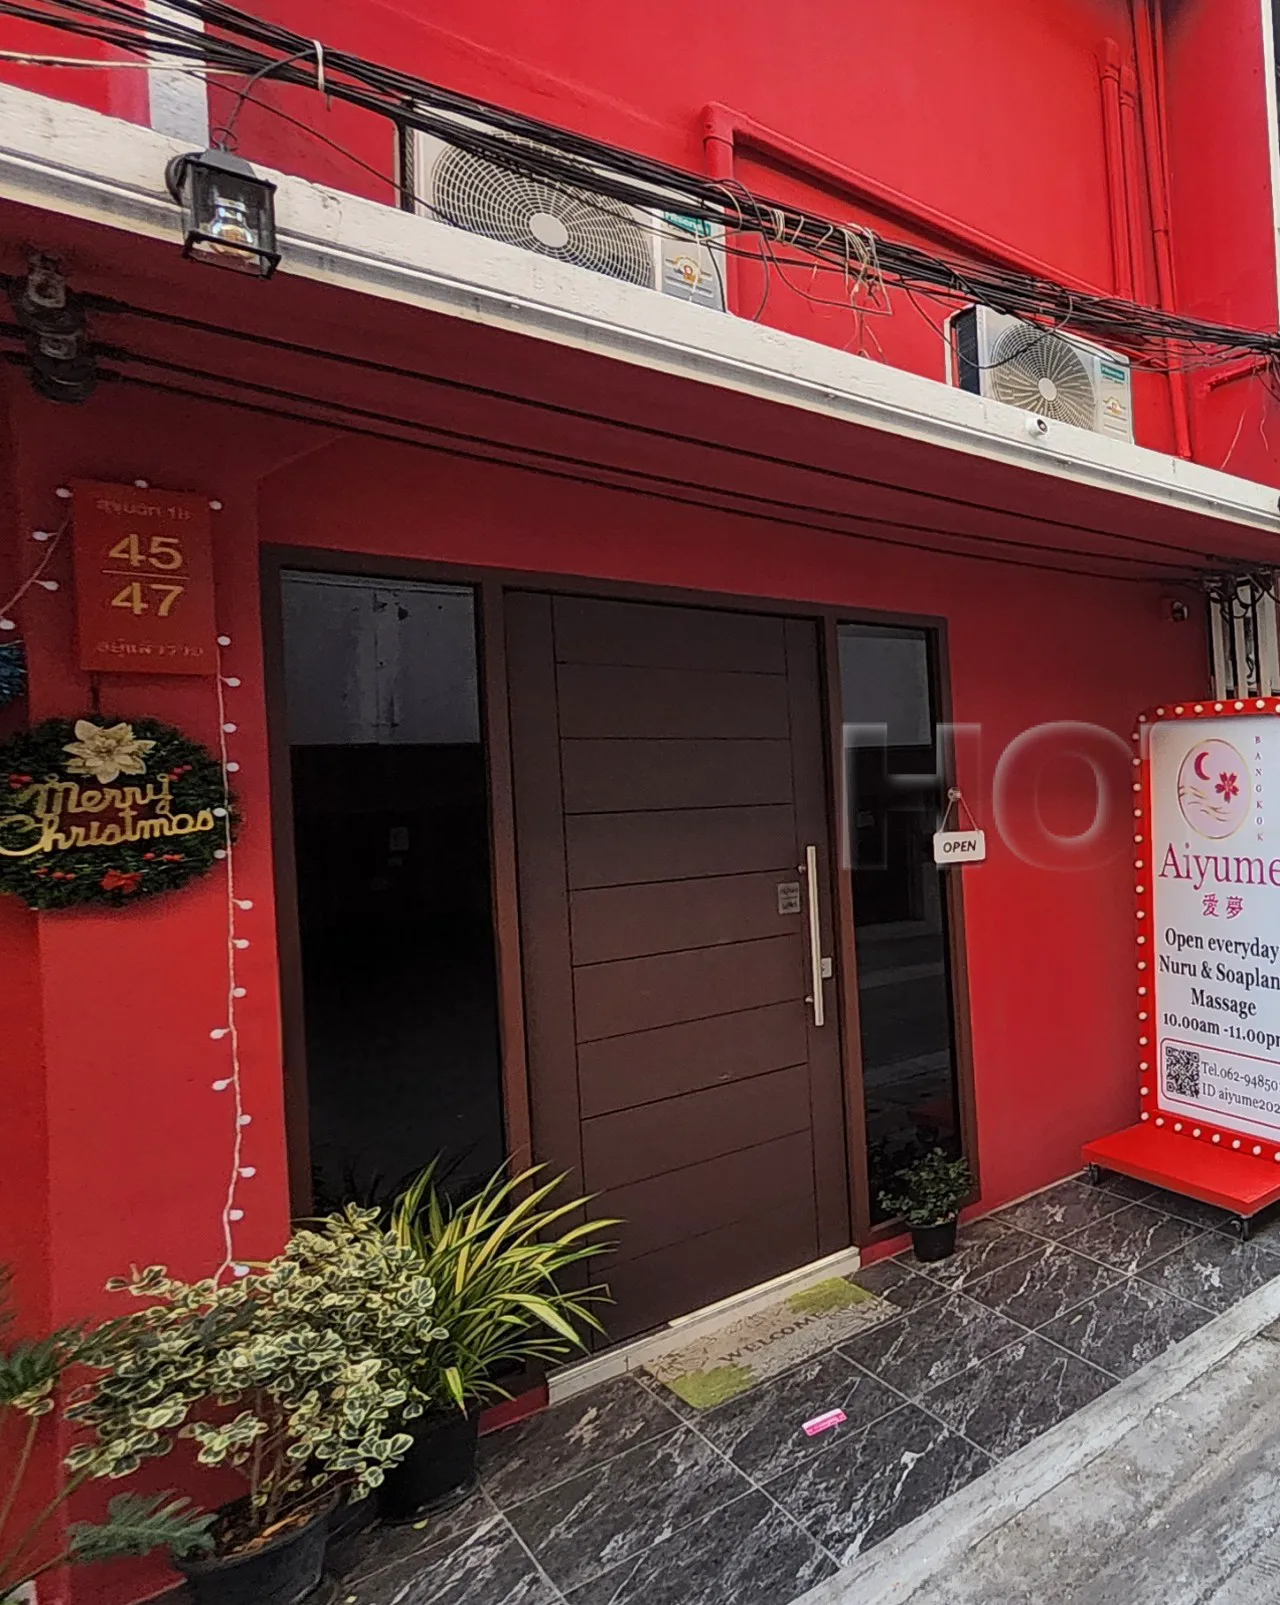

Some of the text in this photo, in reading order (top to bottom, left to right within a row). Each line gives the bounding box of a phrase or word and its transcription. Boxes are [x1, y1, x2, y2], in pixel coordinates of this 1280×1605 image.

[109, 533, 183, 570] 45
[111, 582, 185, 617] 47
[17, 773, 174, 815] Merry
[1254, 735, 1264, 842] BANGKOK
[943, 839, 977, 853] OPEN
[1202, 893, 1244, 919] 愛夢
[1165, 927, 1280, 965] Open everyday
[1159, 954, 1197, 977] Nuru
[1200, 960, 1213, 979] &
[1190, 987, 1257, 1020] Massage
[1163, 1012, 1220, 1036] 10.00am
[1202, 1082, 1216, 1097] ID
